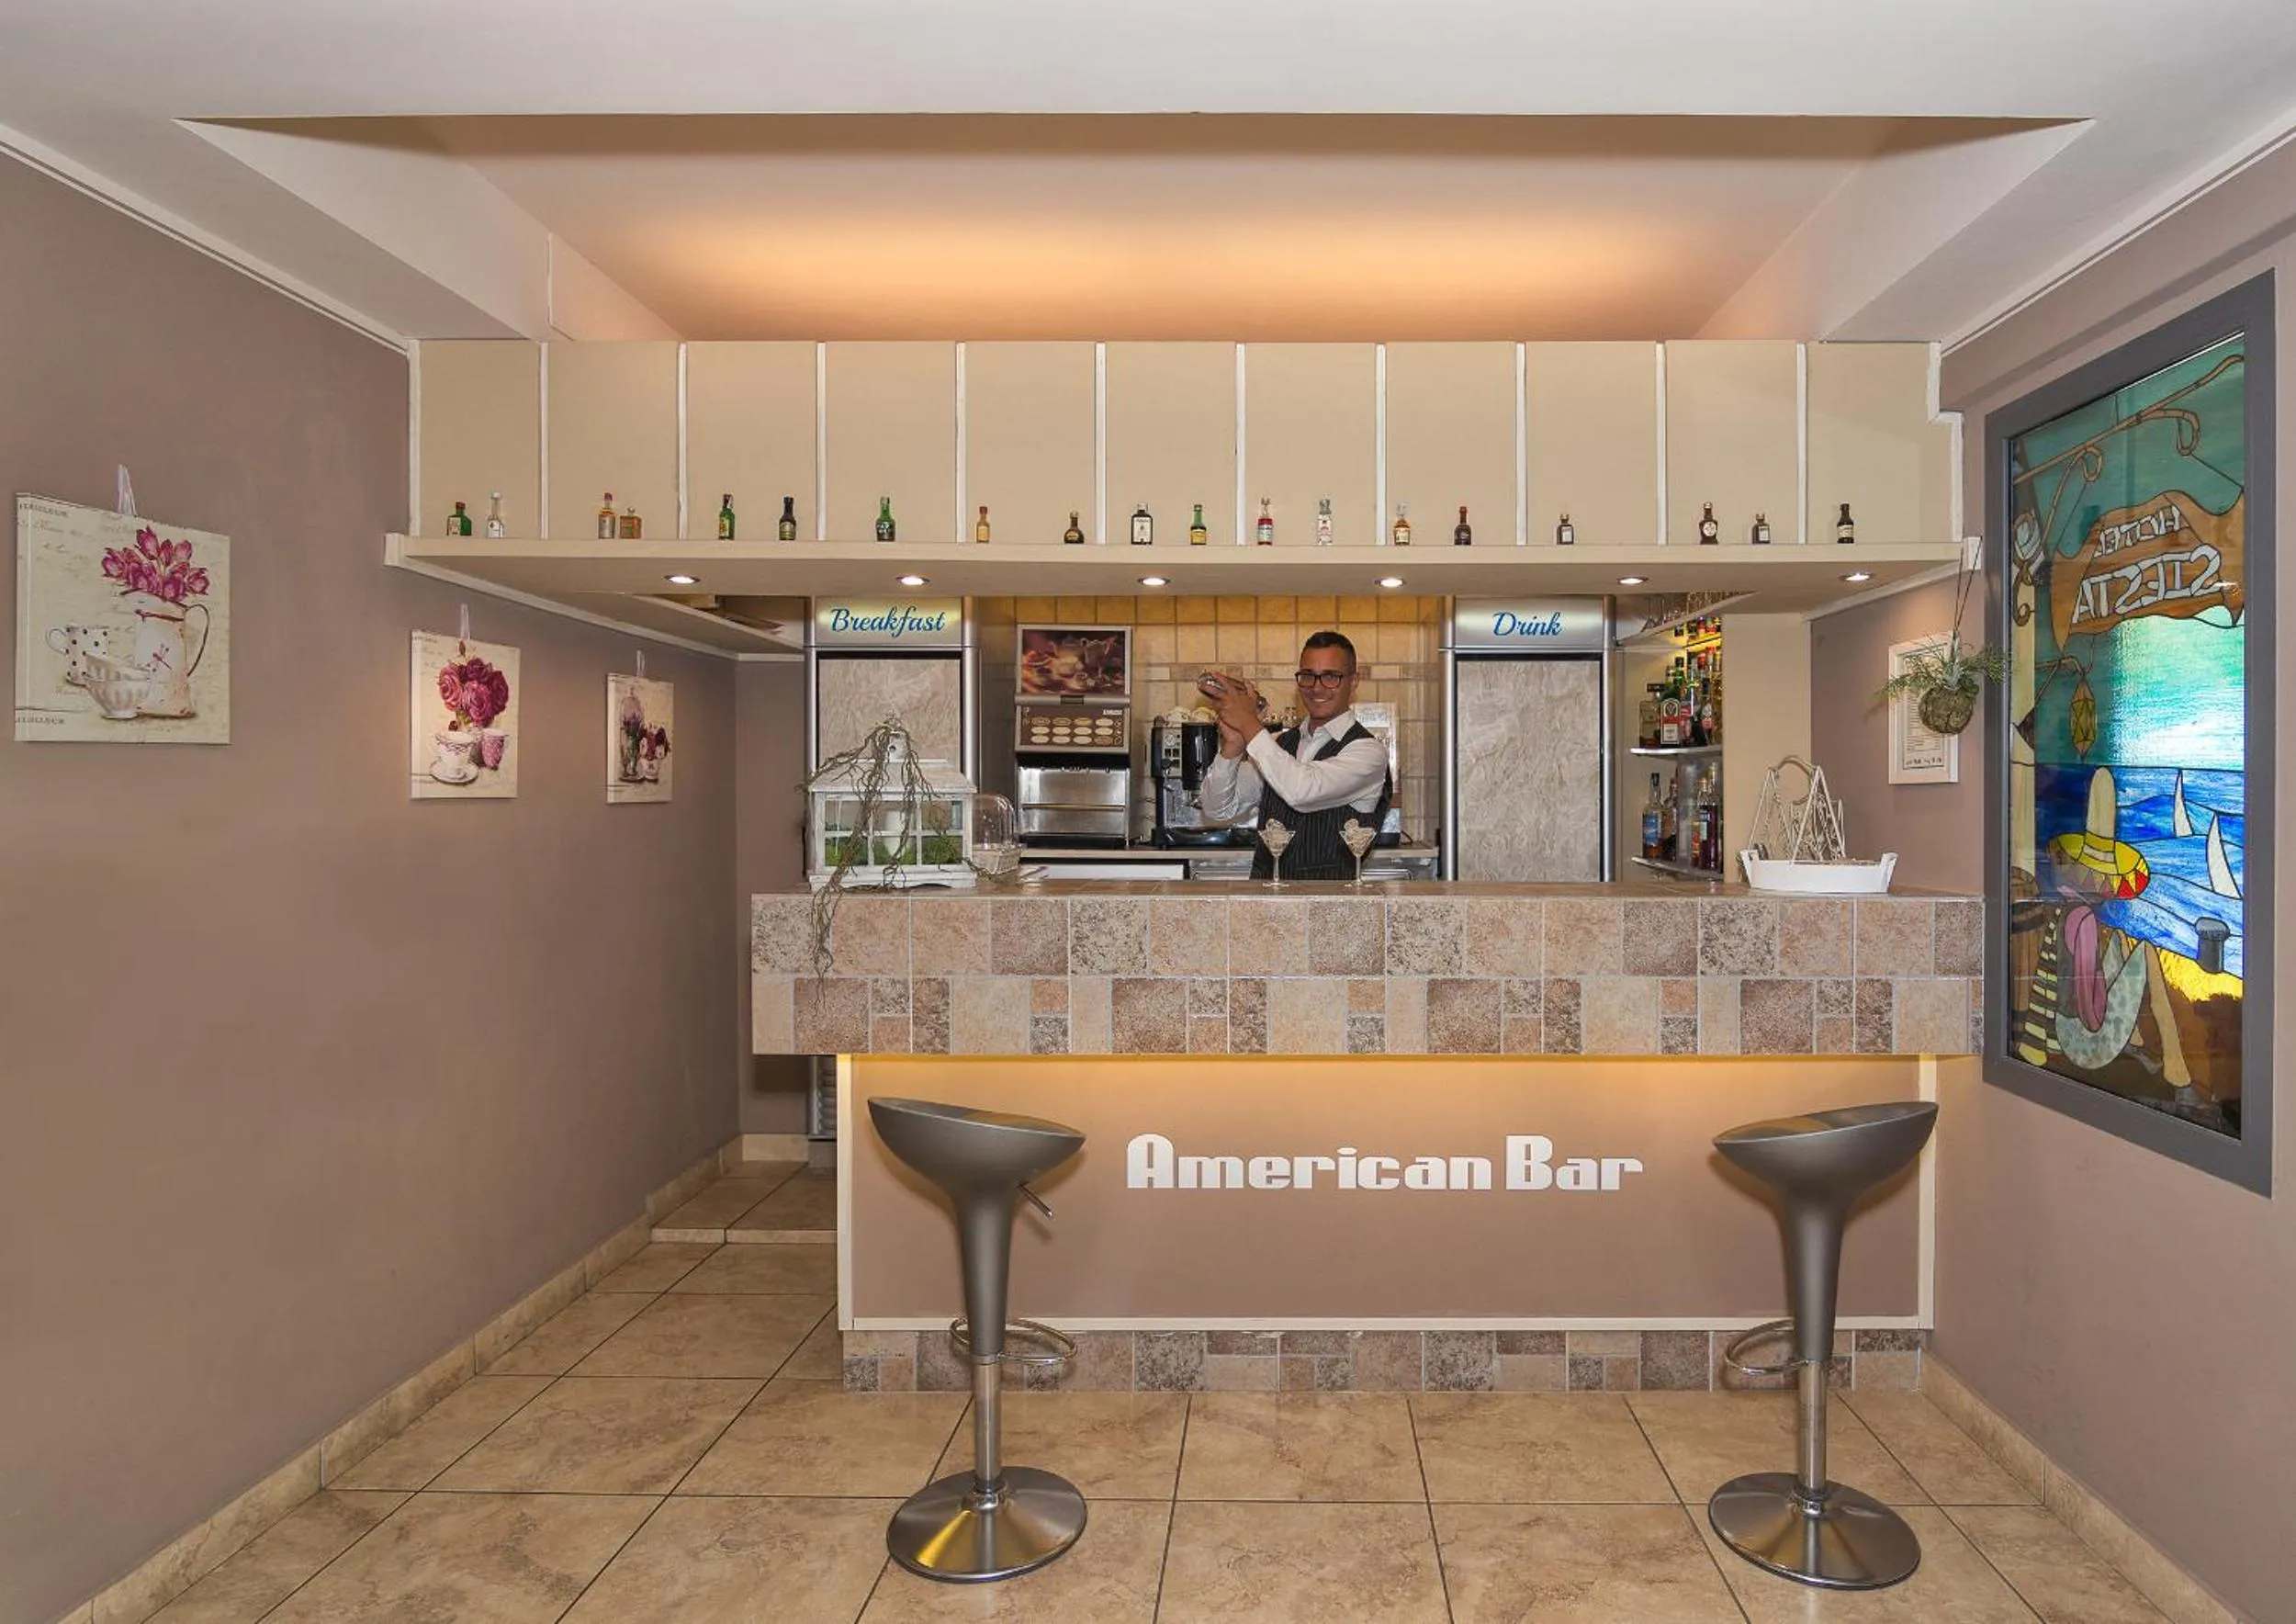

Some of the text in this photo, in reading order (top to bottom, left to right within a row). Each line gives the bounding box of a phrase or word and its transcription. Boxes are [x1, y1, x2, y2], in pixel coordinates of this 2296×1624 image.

[830, 604, 947, 637] Breakfast
[1492, 611, 1563, 637] Drink
[1127, 1133, 1644, 1190] American Bar
